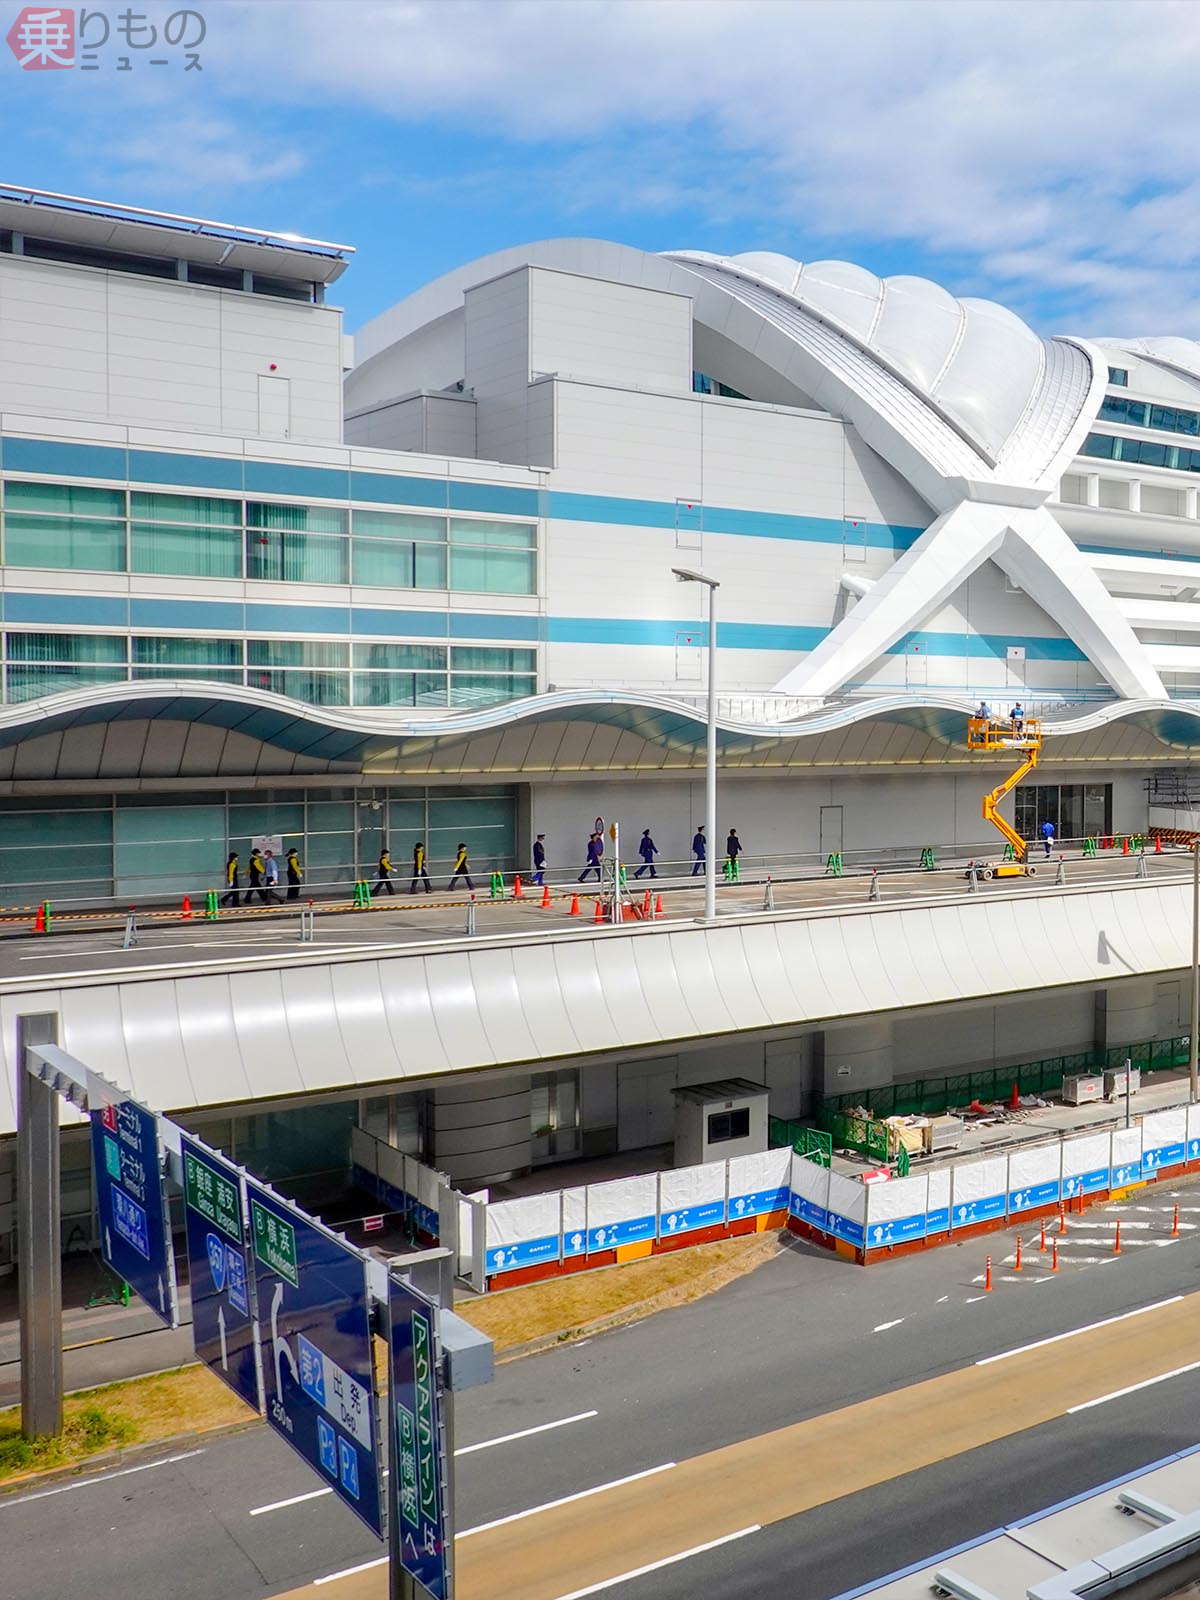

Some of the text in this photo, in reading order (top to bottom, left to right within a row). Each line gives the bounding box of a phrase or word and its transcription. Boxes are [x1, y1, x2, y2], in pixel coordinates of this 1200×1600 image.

[628, 1222, 648, 1232] SAFETY
[699, 1209, 718, 1217] SAFETY
[267, 1215, 291, 1254] 横浜
[529, 1243, 551, 1253] SAFETY
[265, 1242, 296, 1280] Yokohama
[301, 1348, 362, 1415] 第2 出発
[414, 1320, 434, 1506] アクアライン
[320, 1425, 357, 1490] P3 P4
